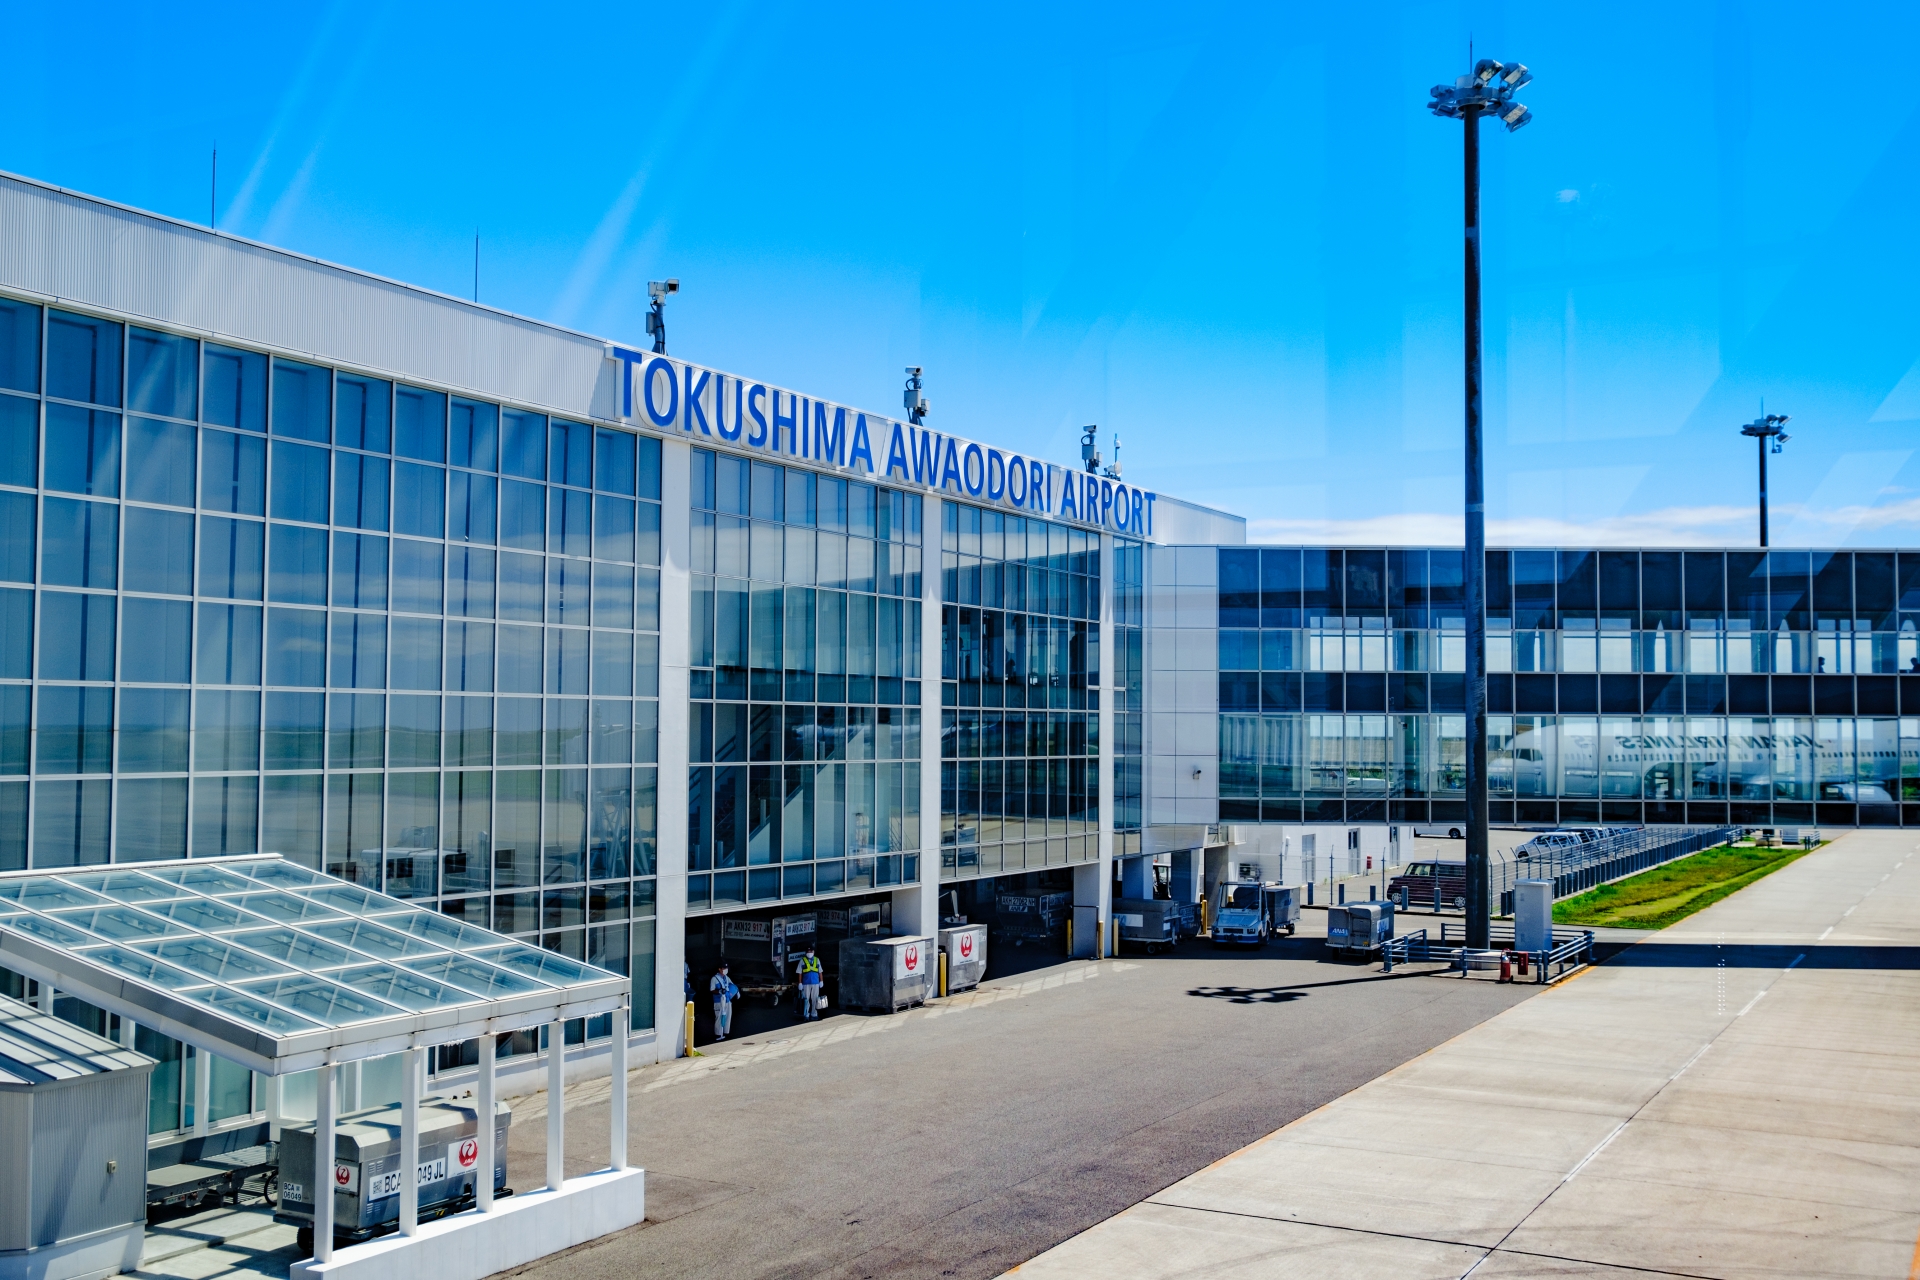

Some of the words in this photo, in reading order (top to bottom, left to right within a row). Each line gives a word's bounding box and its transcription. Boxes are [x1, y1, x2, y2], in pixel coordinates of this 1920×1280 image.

[608, 346, 875, 474] TOKUSHIMA
[884, 426, 1053, 515] AWAODORI
[1059, 469, 1156, 537] AIRPORT
[434, 1161, 444, 1180] JL
[283, 1182, 295, 1192] BCA
